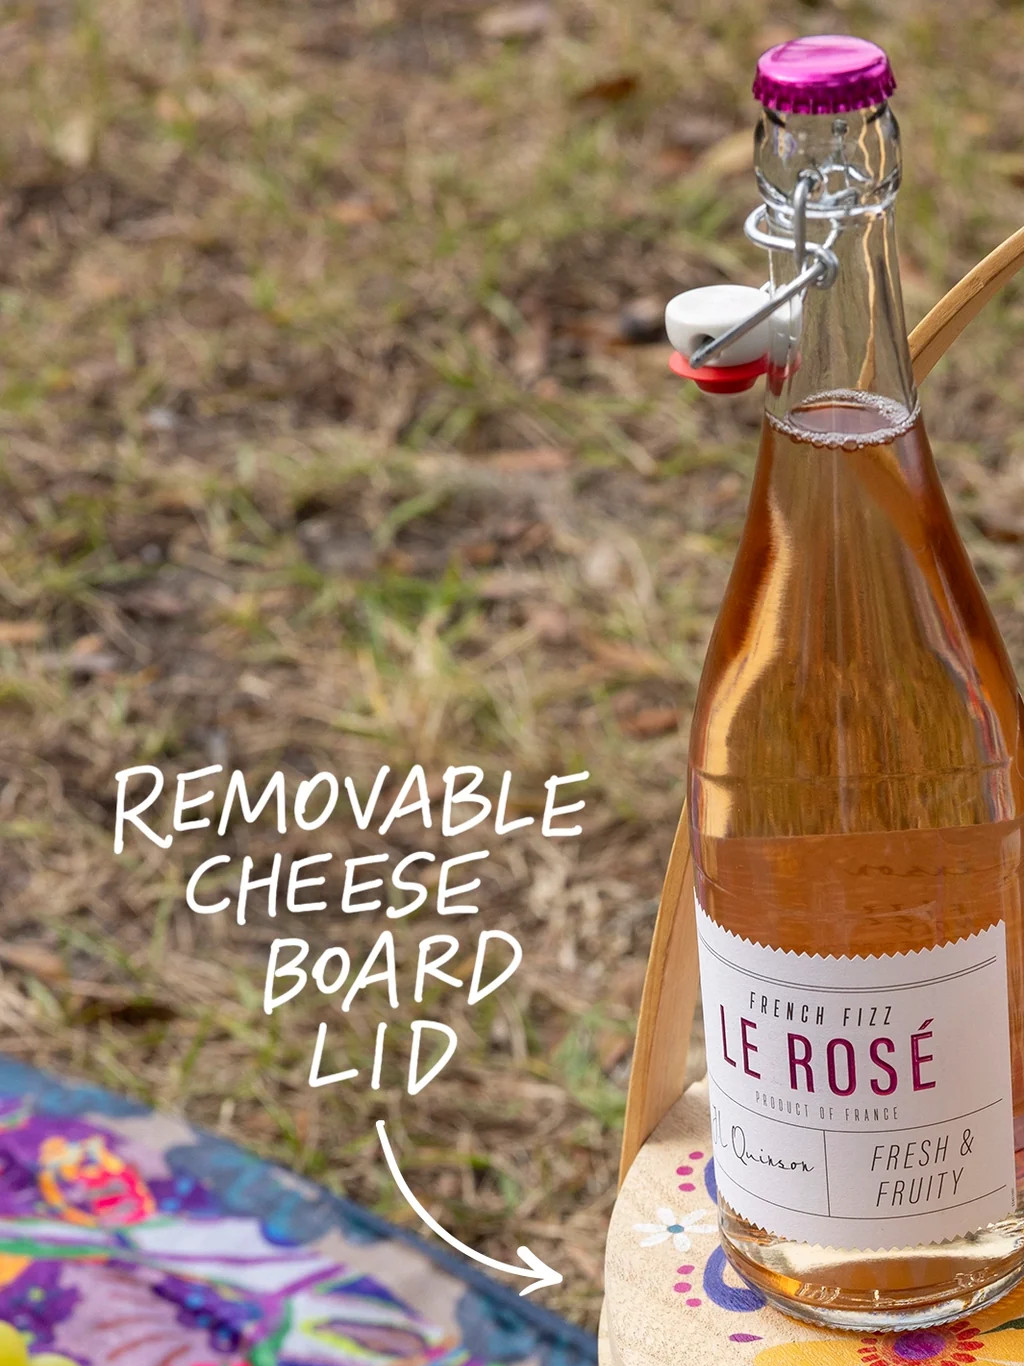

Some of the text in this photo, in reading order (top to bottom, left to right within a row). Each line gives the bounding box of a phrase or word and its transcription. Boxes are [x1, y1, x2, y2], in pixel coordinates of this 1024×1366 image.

[749, 991, 893, 1027] FRENCH FIZZ
[719, 1004, 937, 1097] LE ROSÉ
[756, 1091, 898, 1122] PRODUCT OF FRANCE
[871, 1128, 975, 1172] FRESH &
[876, 1167, 965, 1207] FRUITY
